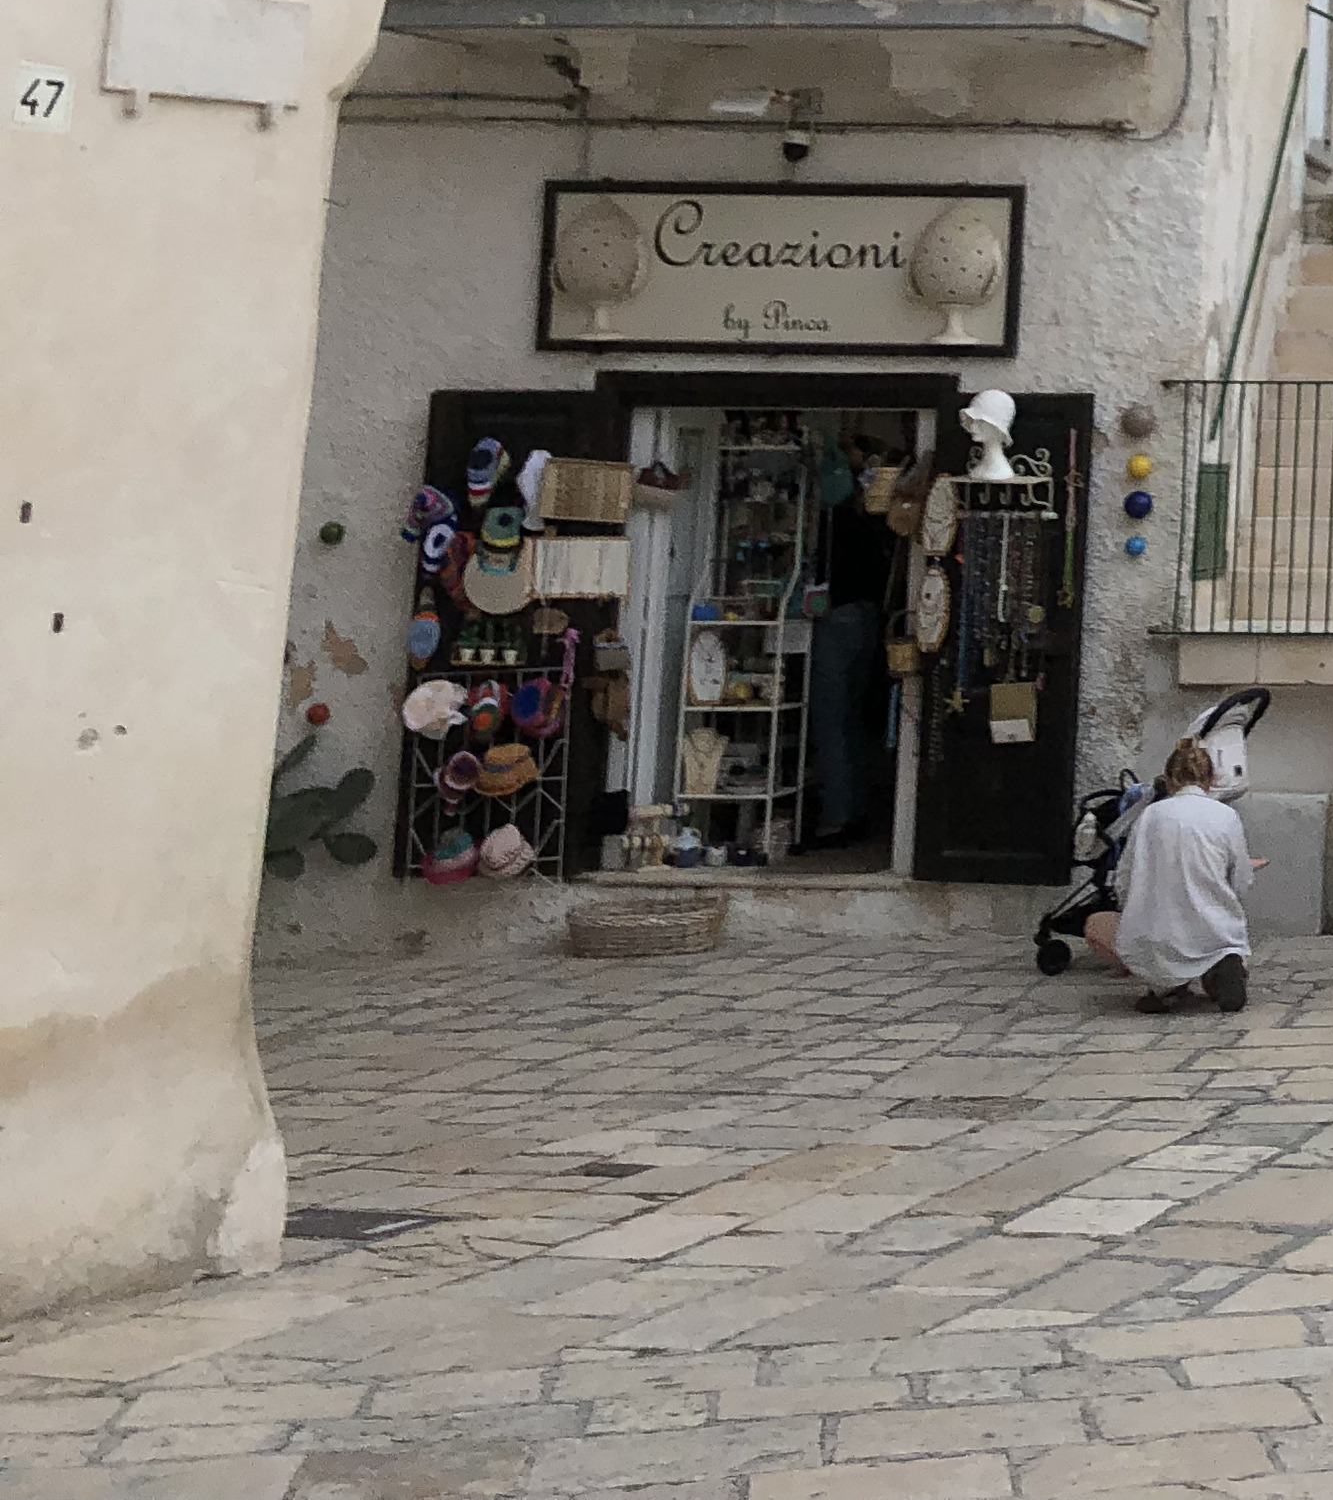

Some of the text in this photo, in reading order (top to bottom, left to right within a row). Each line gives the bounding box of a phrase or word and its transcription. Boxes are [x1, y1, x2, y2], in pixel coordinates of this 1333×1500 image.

[19, 77, 66, 118] 47
[653, 199, 904, 270] Creazioni
[722, 301, 752, 340] by
